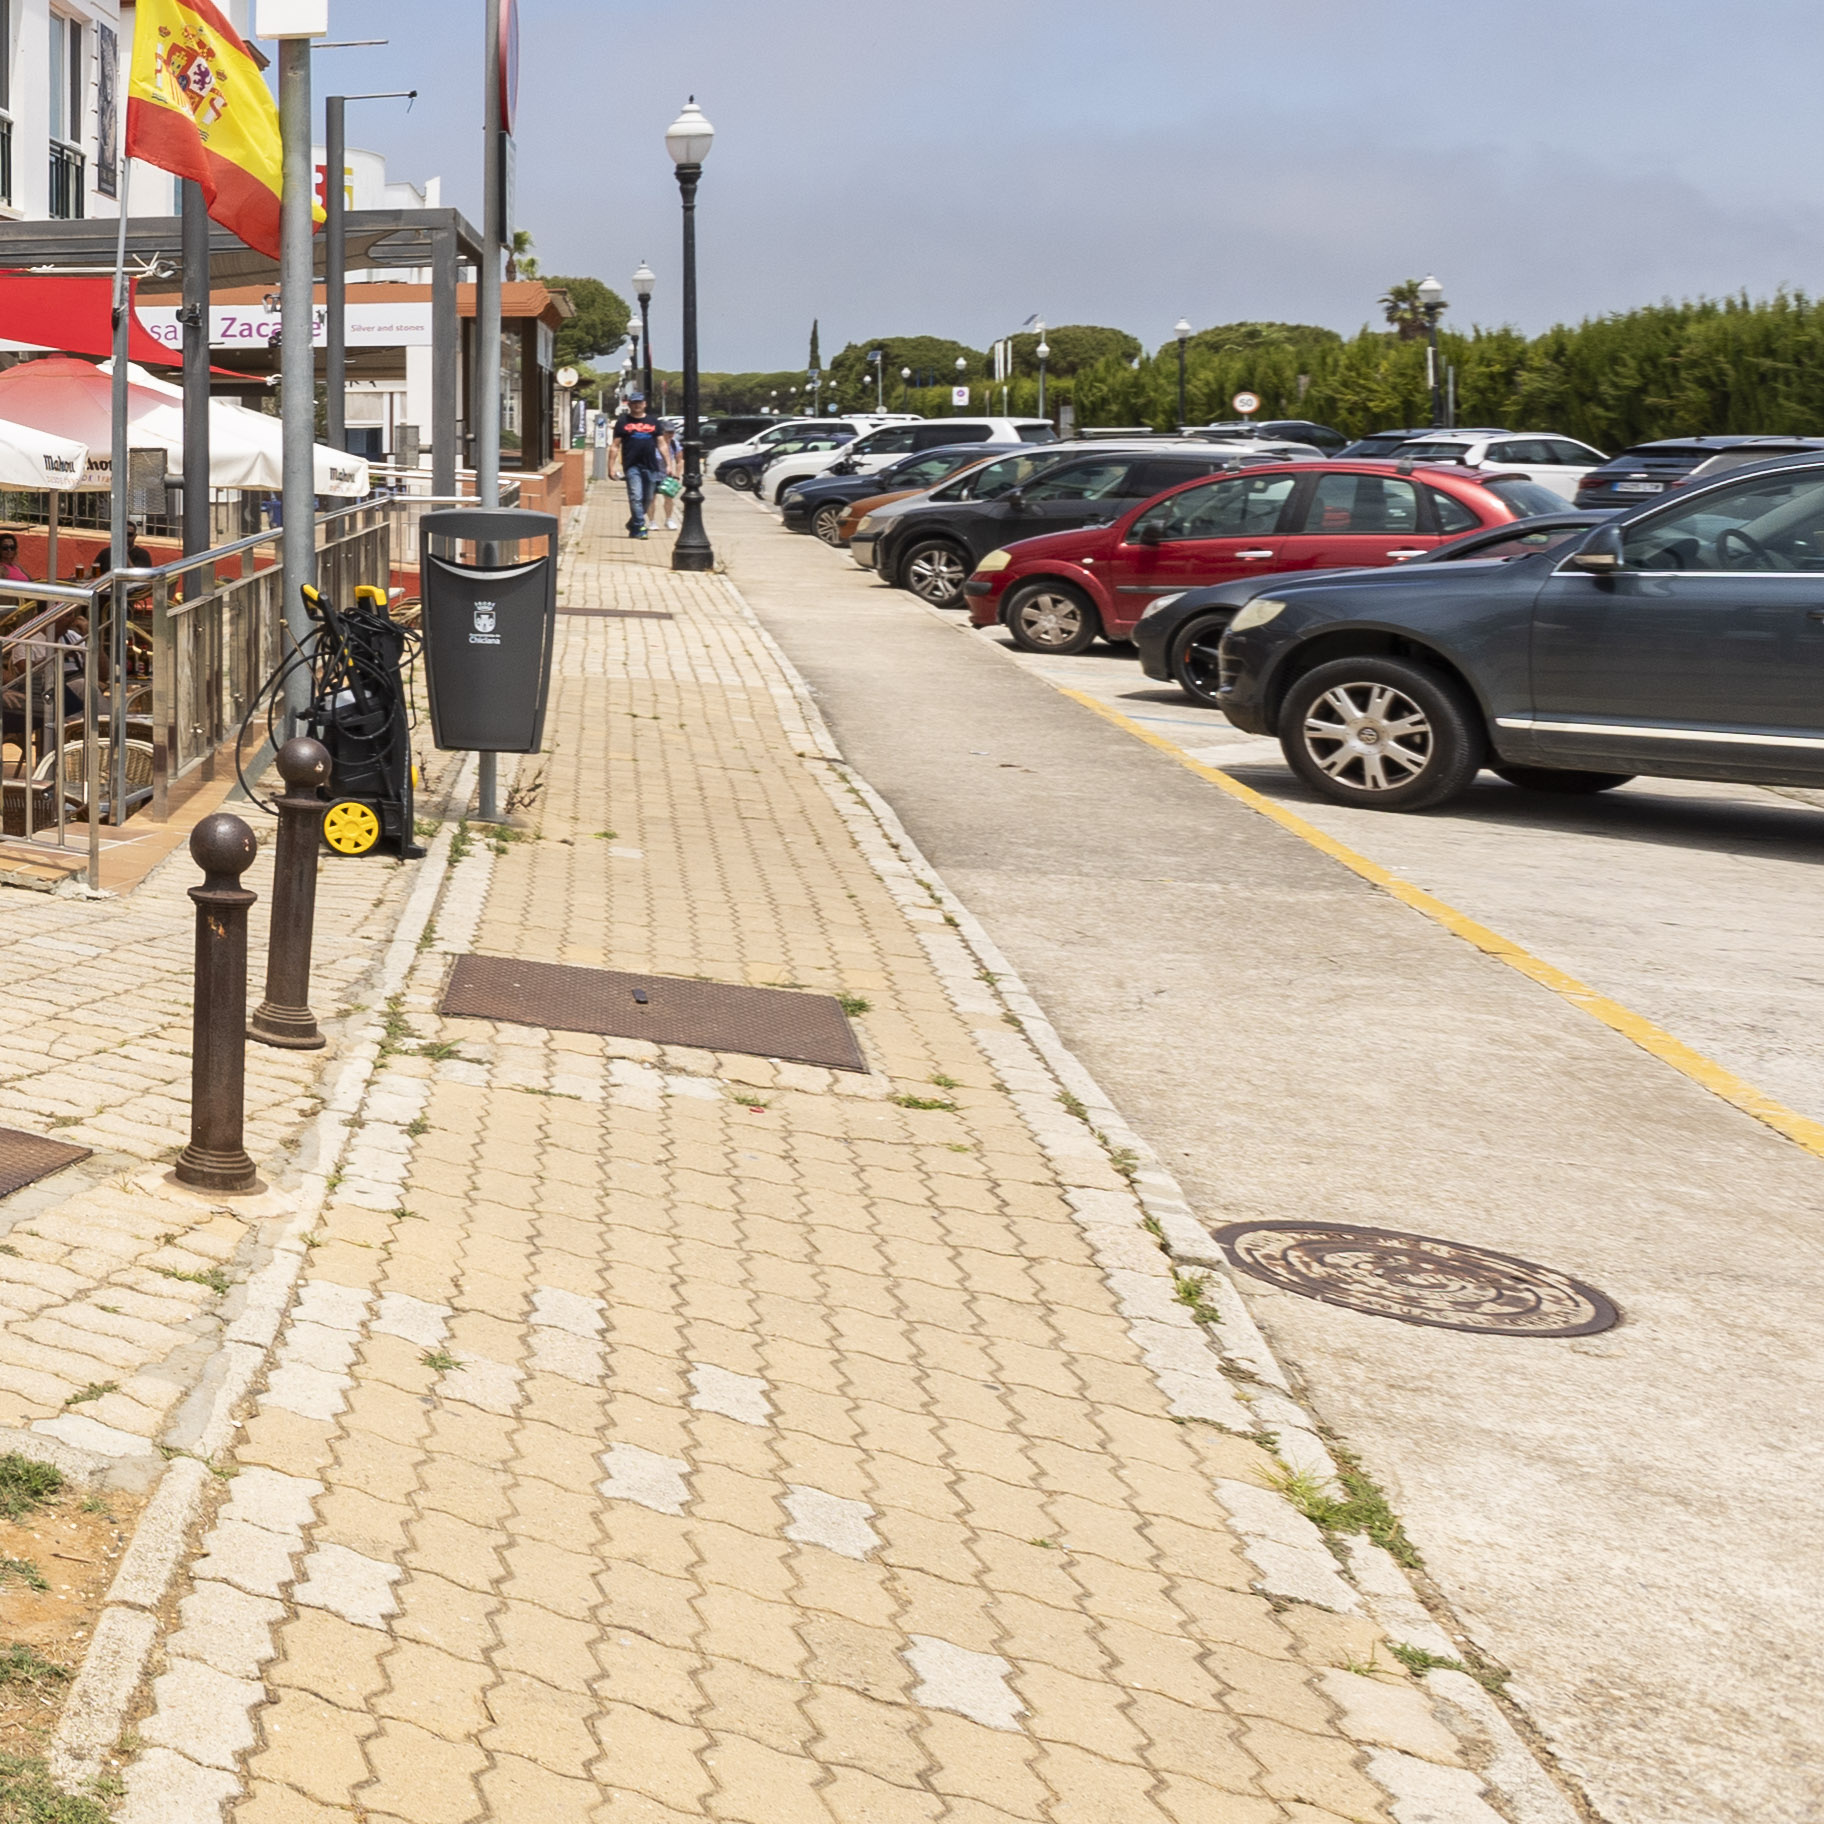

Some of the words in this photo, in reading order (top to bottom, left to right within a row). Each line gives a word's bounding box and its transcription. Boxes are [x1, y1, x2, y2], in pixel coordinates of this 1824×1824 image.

[377, 324, 394, 332] and
[1239, 398, 1254, 407] 50
[42, 454, 76, 473] Mahou
